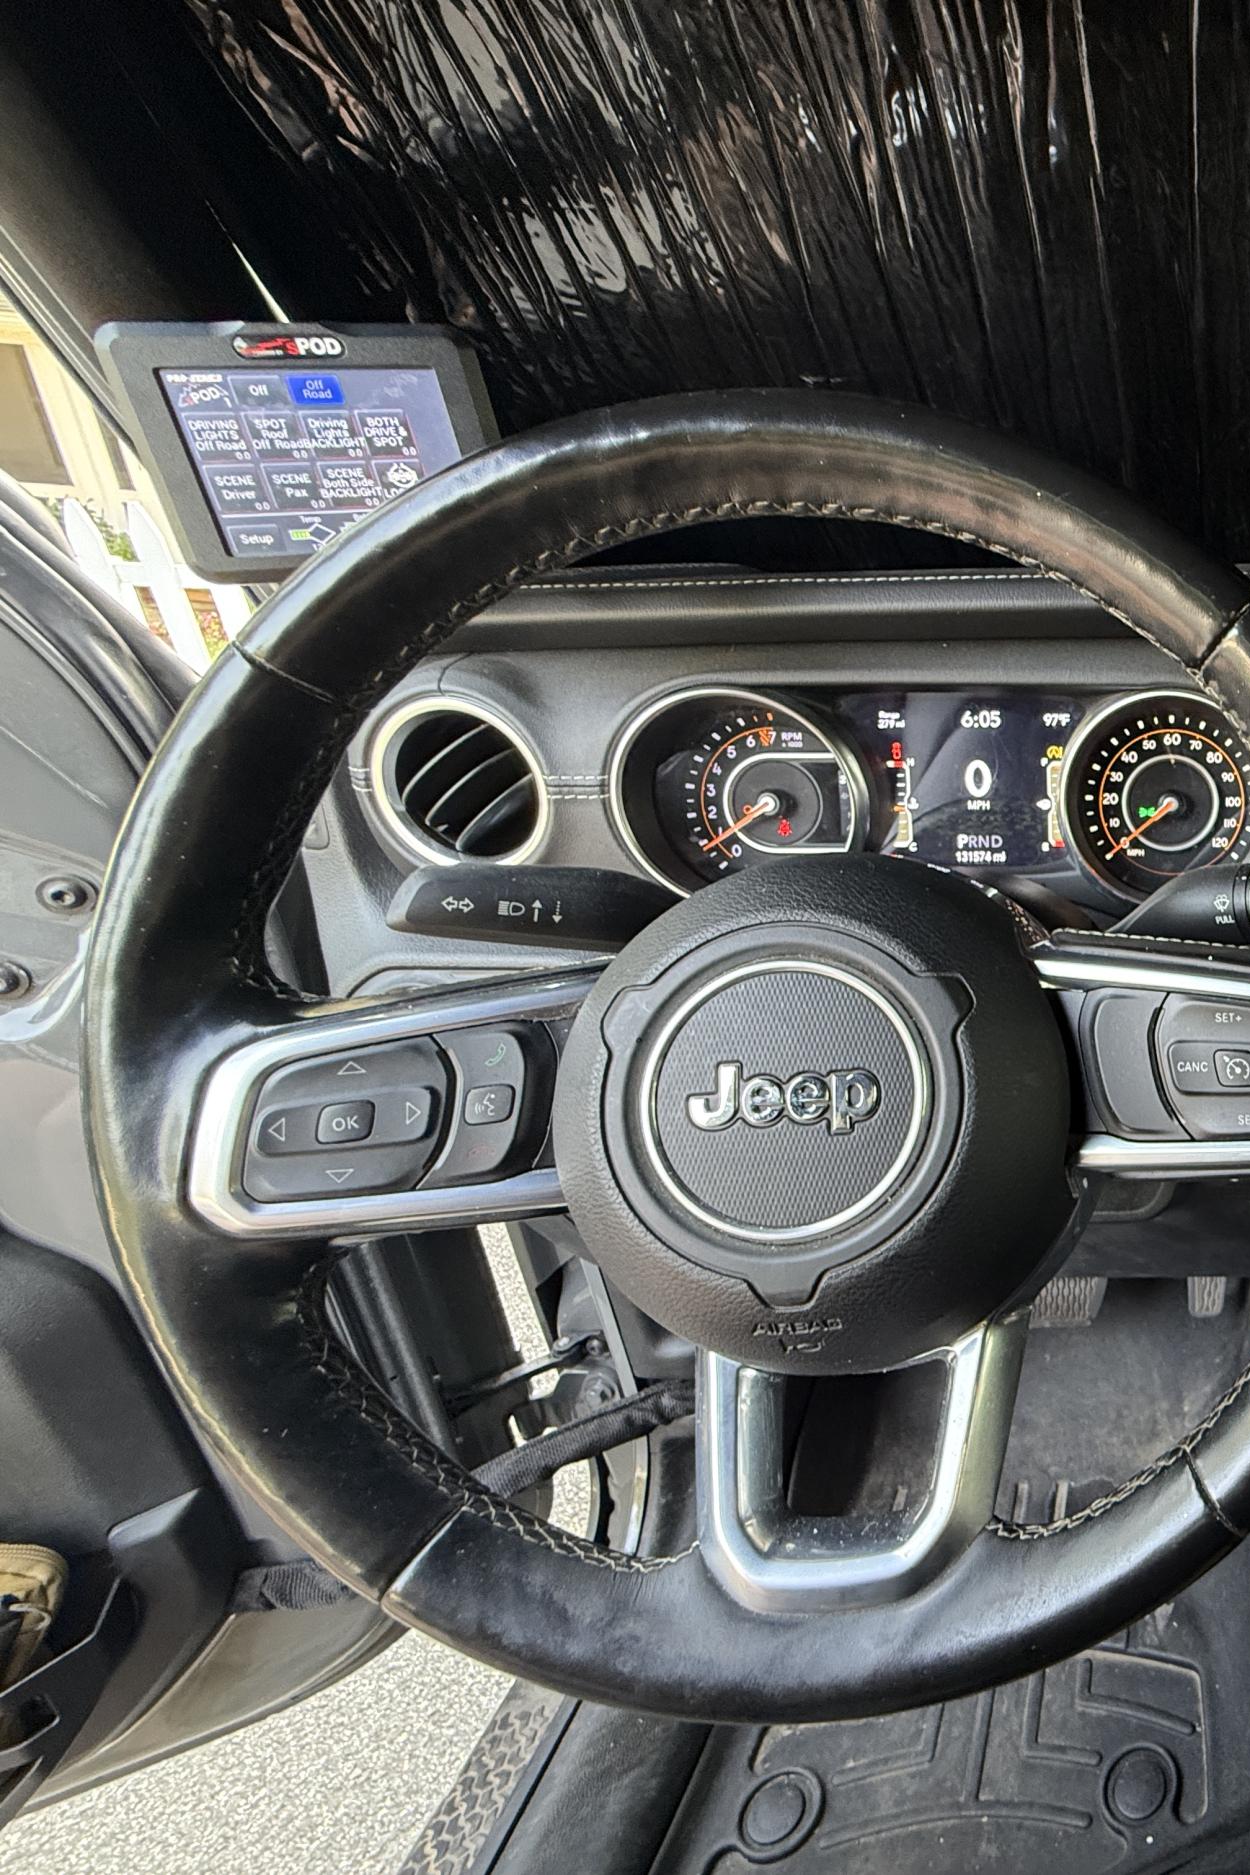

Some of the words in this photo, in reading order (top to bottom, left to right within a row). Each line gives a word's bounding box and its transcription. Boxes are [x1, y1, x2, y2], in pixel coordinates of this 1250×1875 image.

[249, 384, 270, 396] Off
[306, 380, 324, 389] Off
[303, 389, 333, 399] Road
[189, 419, 239, 430] DRIVING
[254, 418, 287, 429] SPOT
[308, 418, 348, 430] Driving
[366, 417, 400, 427] BOTH
[194, 430, 240, 440] LIGHTS
[261, 429, 289, 440] Roof
[315, 428, 350, 440] Lights
[364, 426, 397, 436] DRIVE
[196, 440, 215, 451] Off
[216, 440, 247, 450] Road
[253, 440, 271, 450] Off
[276, 439, 304, 449] Road
[303, 438, 367, 449] BACKLIGHT
[374, 437, 404, 447] SPOT
[327, 468, 364, 478] SCENE
[214, 475, 256, 486] SCENE
[272, 473, 312, 485] SCENE
[323, 478, 350, 488] Both
[351, 478, 375, 487] Side
[223, 490, 257, 500] Driver
[285, 487, 309, 498] Pax
[321, 487, 383, 498] BACKLIGHT
[240, 534, 274, 546] Setup
[960, 710, 1002, 729] 6:05
[746, 735, 756, 748] 6
[769, 731, 777, 744] 7
[781, 732, 803, 741] RPM
[1163, 733, 1181, 746] 60
[1142, 740, 1156, 750] 50
[1189, 740, 1203, 750] 70
[727, 745, 737, 759] 5
[1121, 751, 1138, 764] 40
[1206, 751, 1223, 764] 80
[712, 763, 722, 775] 4
[964, 759, 993, 798] 0
[1110, 772, 1124, 783] 30
[1221, 772, 1235, 783] 90
[706, 784, 716, 797] 3
[1103, 792, 1119, 805] 20
[1225, 796, 1241, 807] 100
[967, 801, 990, 811] MPH
[708, 805, 717, 819] 2
[1109, 818, 1120, 829] 10
[1224, 819, 1237, 829] 110
[1212, 837, 1228, 848] 120
[731, 844, 742, 857] 0
[1127, 849, 1145, 857] MPH
[955, 851, 991, 863] 131574
[1215, 915, 1235, 924] PULL
[1177, 1061, 1209, 1072] CANC
[687, 1060, 882, 1136] Jeep
[331, 1114, 360, 1131] OK
[752, 1318, 843, 1337] AIRBAG
